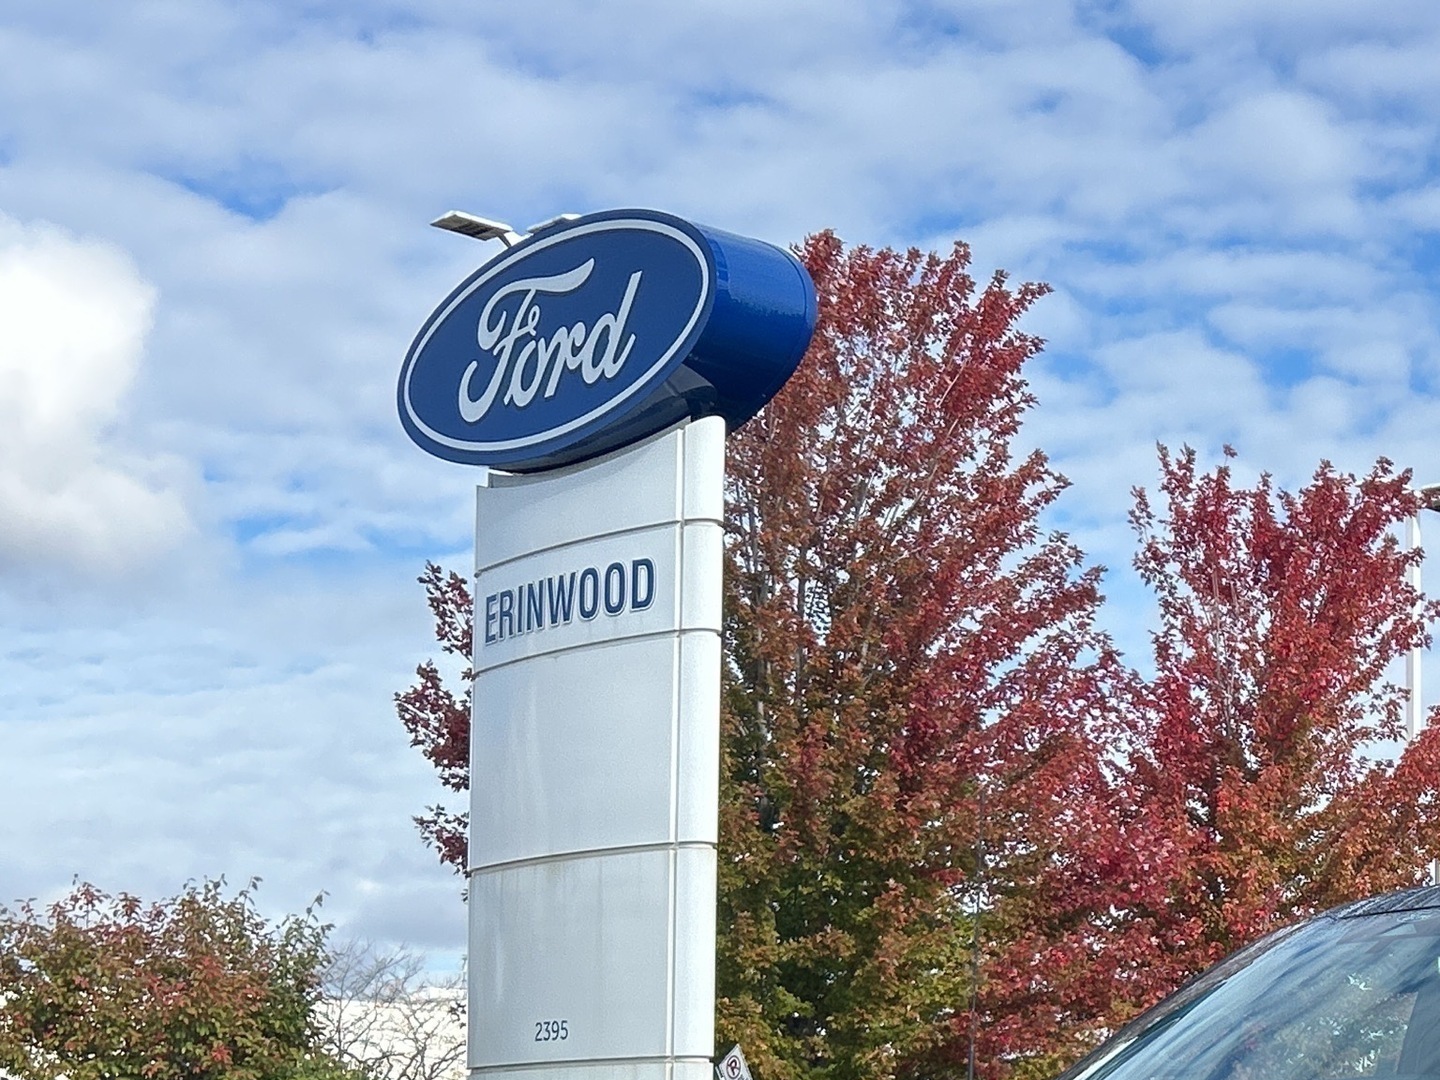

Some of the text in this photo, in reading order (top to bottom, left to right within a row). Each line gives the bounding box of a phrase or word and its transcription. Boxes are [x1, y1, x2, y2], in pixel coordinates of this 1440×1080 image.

[458, 257, 643, 423] Ford
[484, 557, 656, 646] ERINWOOD
[534, 1020, 569, 1042] 2395
